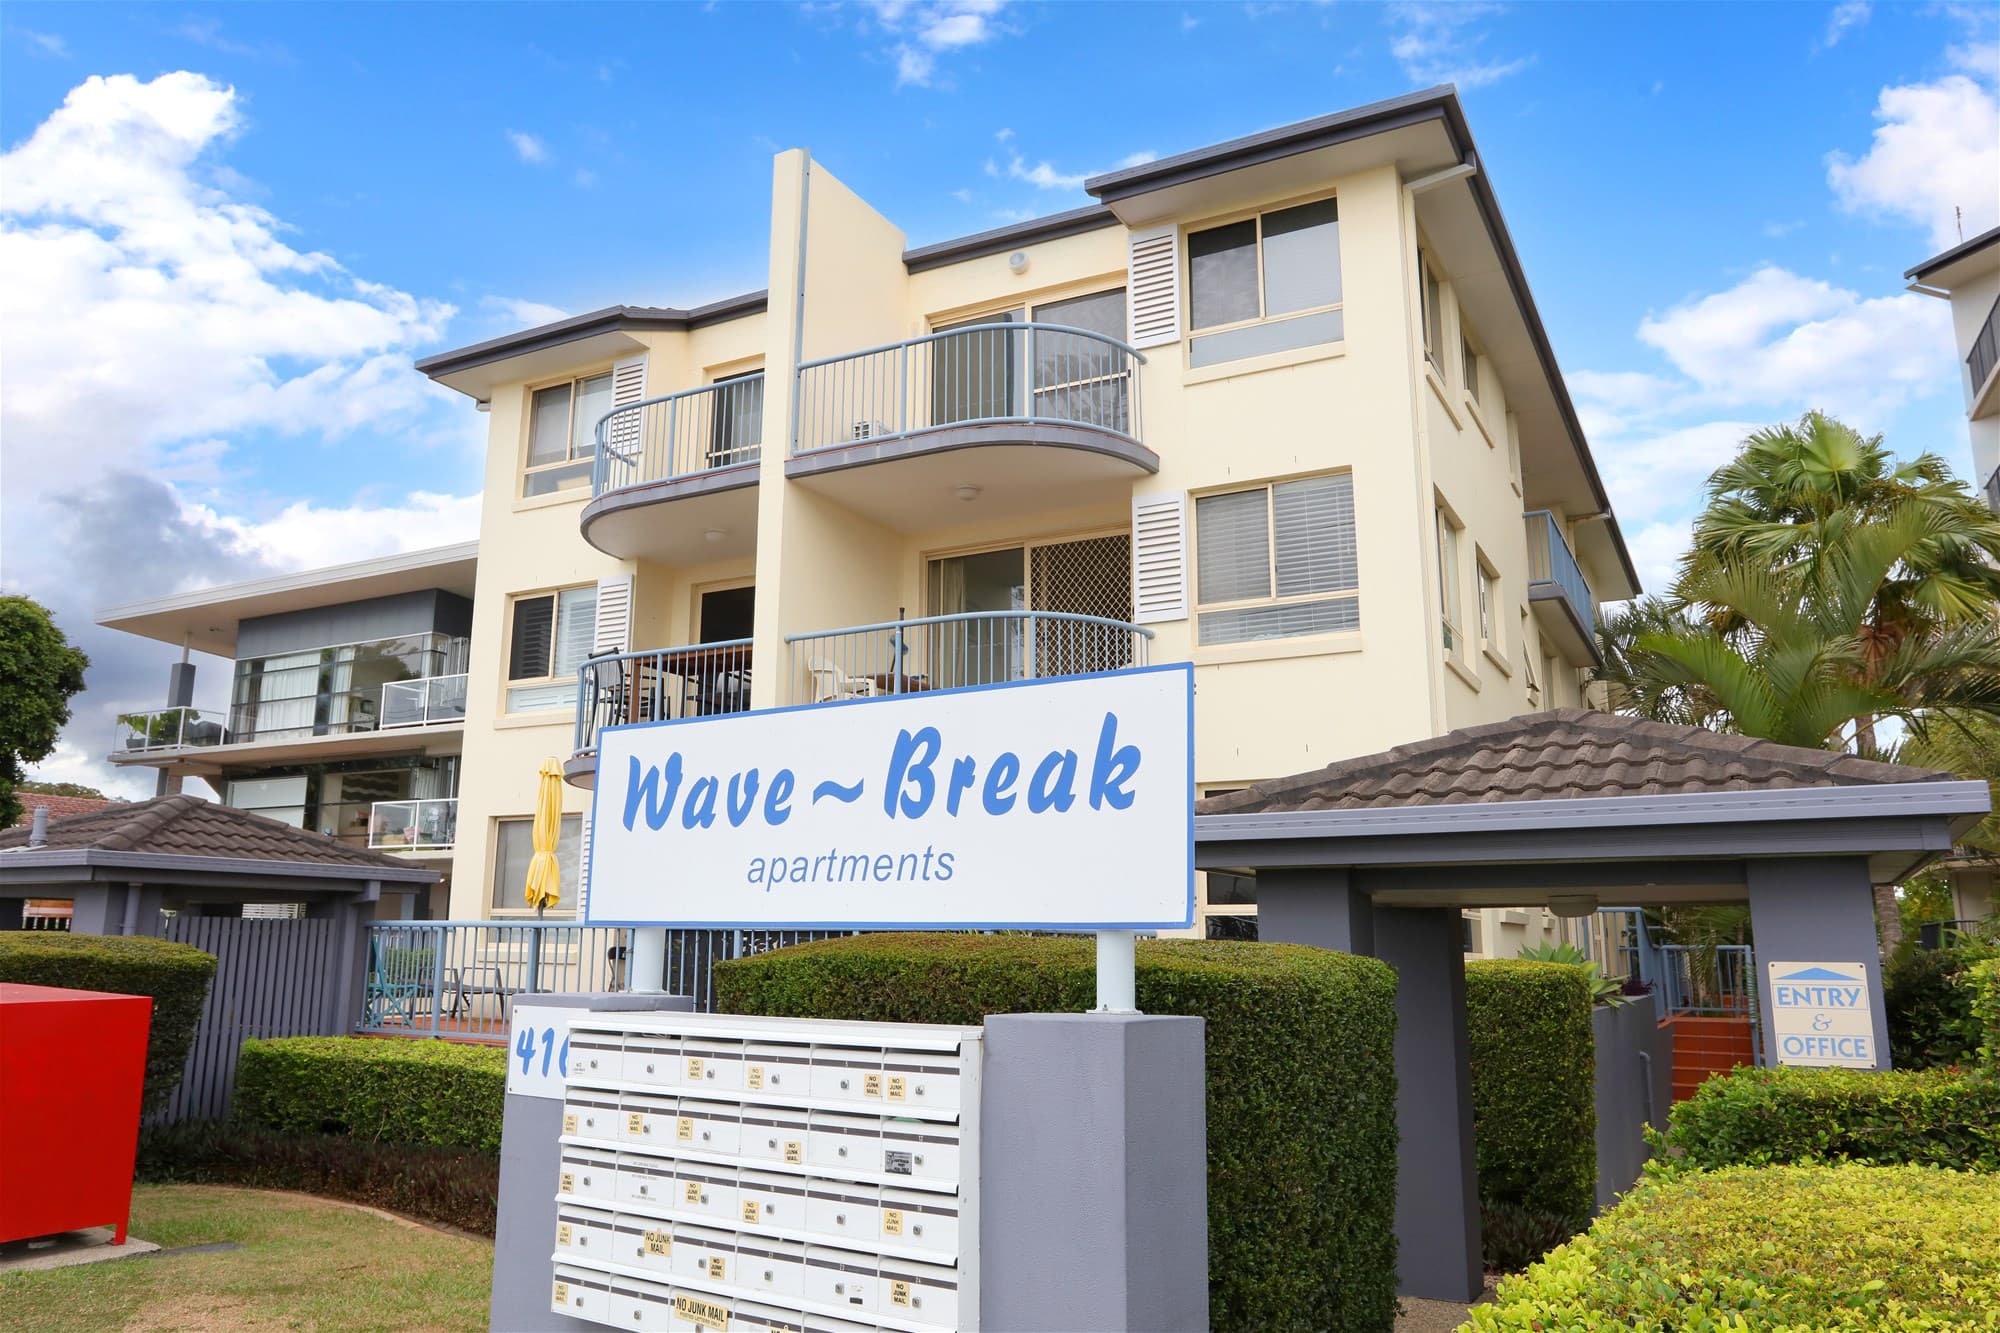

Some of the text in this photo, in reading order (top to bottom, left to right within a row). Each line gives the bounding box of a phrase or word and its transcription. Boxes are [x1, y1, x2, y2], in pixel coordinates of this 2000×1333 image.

[623, 751, 795, 832] Wave
[883, 711, 1142, 820] Break
[746, 846, 955, 892] apartments
[1776, 986, 1861, 1007] ENTRY
[1812, 1013, 1832, 1031] &
[1783, 1036, 1868, 1058] OFFICE
[645, 1232, 671, 1244] NO JUNK
[650, 1243, 665, 1254] MAIL
[676, 1297, 725, 1322] NO JUNK MAIL
